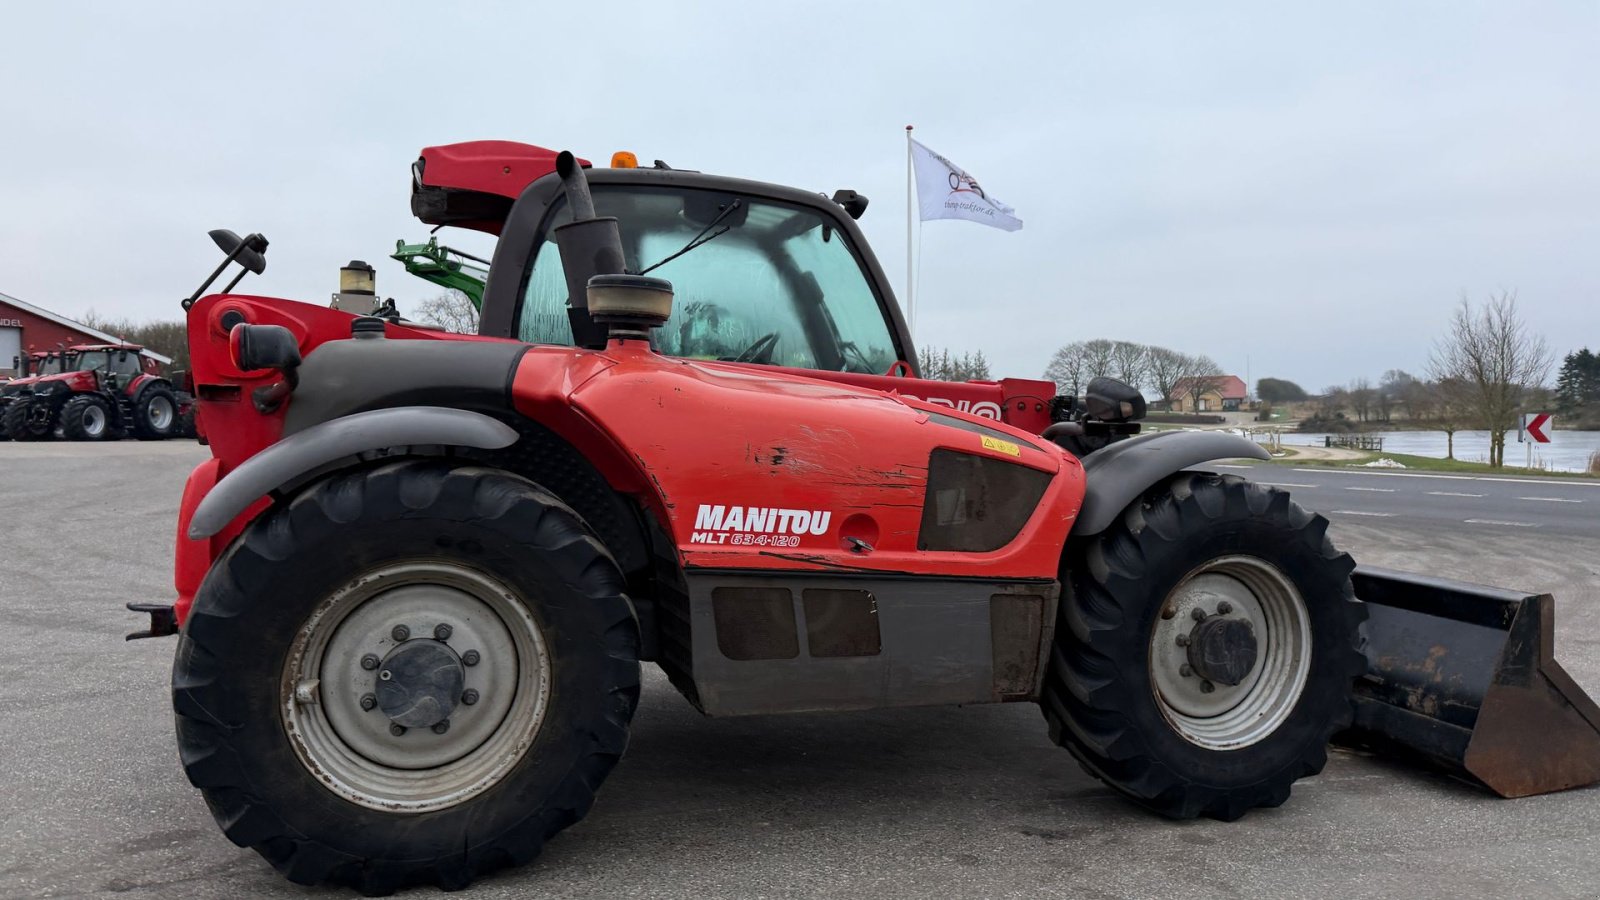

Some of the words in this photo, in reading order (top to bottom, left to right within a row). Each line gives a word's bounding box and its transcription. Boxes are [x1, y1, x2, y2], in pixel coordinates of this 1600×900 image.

[694, 504, 831, 536] MANITOU
[690, 532, 730, 544] MLT
[730, 533, 801, 547] 634-120
